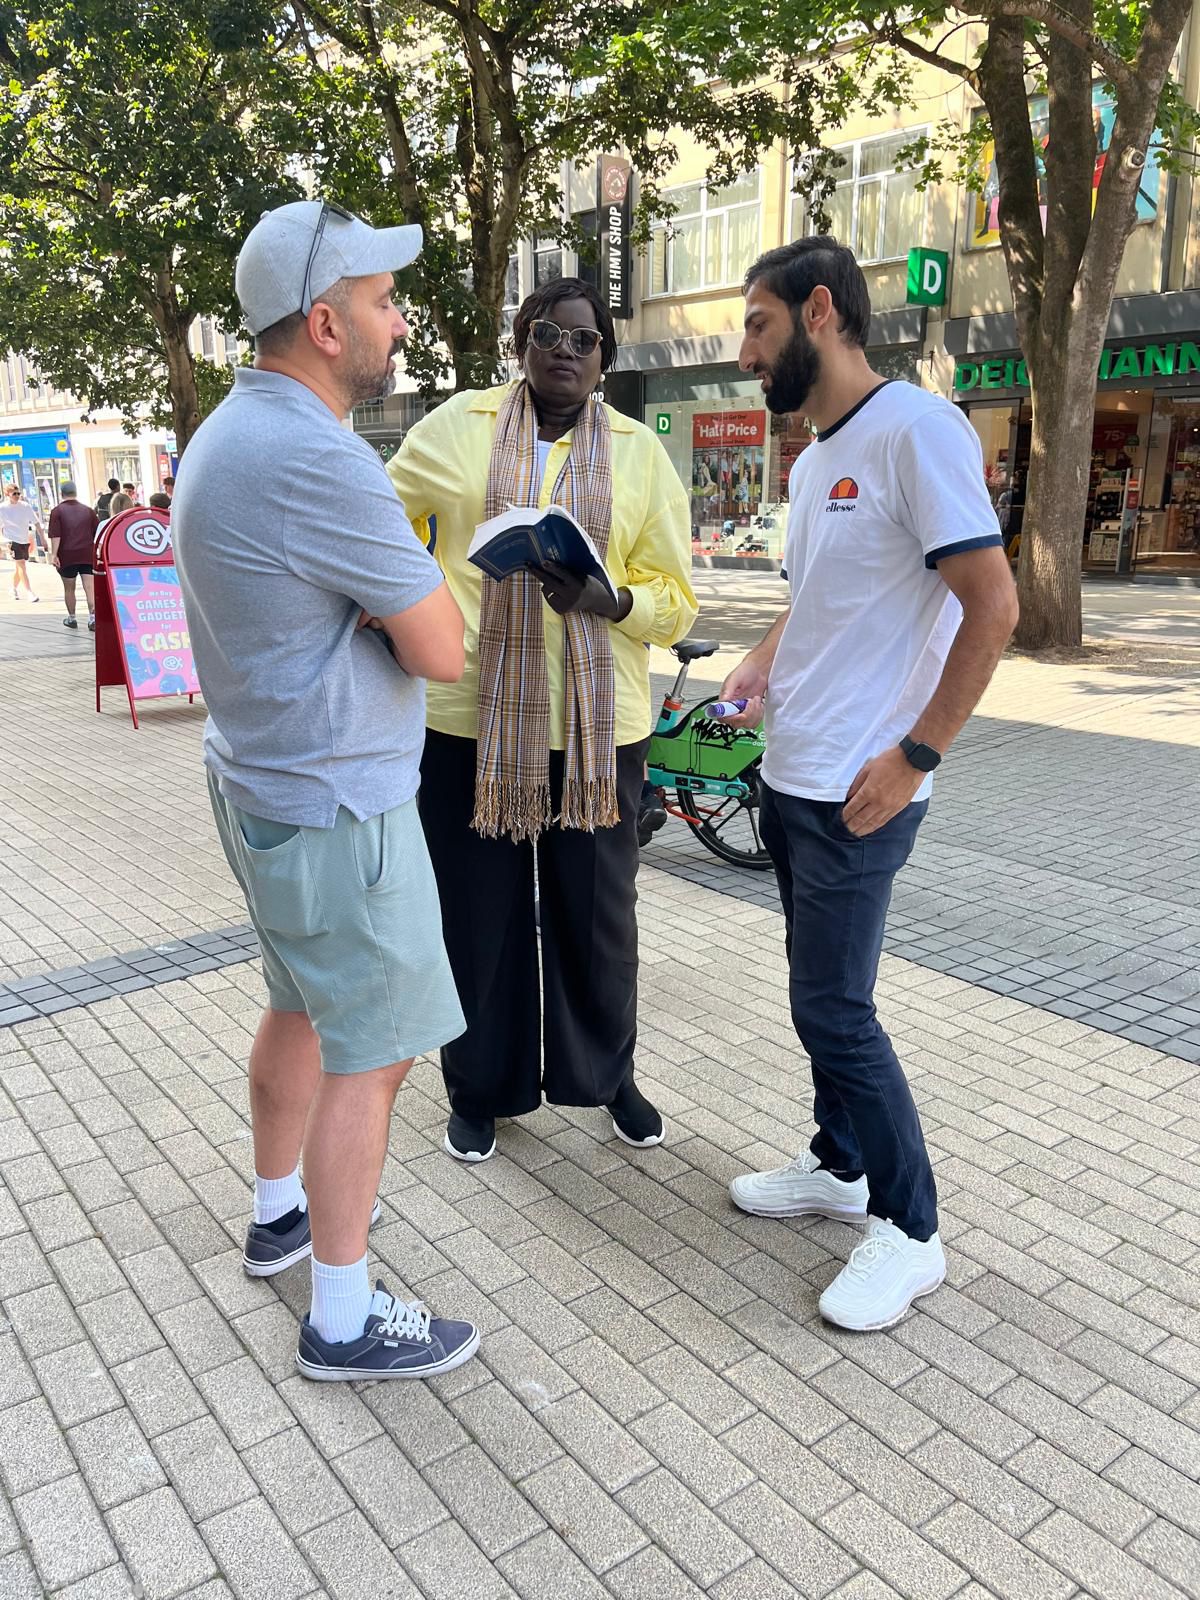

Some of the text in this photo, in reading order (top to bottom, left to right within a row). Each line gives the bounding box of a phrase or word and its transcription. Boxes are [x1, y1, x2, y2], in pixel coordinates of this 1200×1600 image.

[609, 206, 622, 245] SHOP
[609, 247, 621, 280] HMV
[923, 259, 942, 295] D
[609, 282, 621, 308] THE
[955, 341, 1200, 392] DEIANN
[589, 391, 604, 402] OP
[659, 416, 670, 431] D
[700, 423, 757, 438] Half Price
[825, 502, 856, 512] ellesse
[136, 599, 176, 609] GAMES
[138, 611, 187, 622] GADGET
